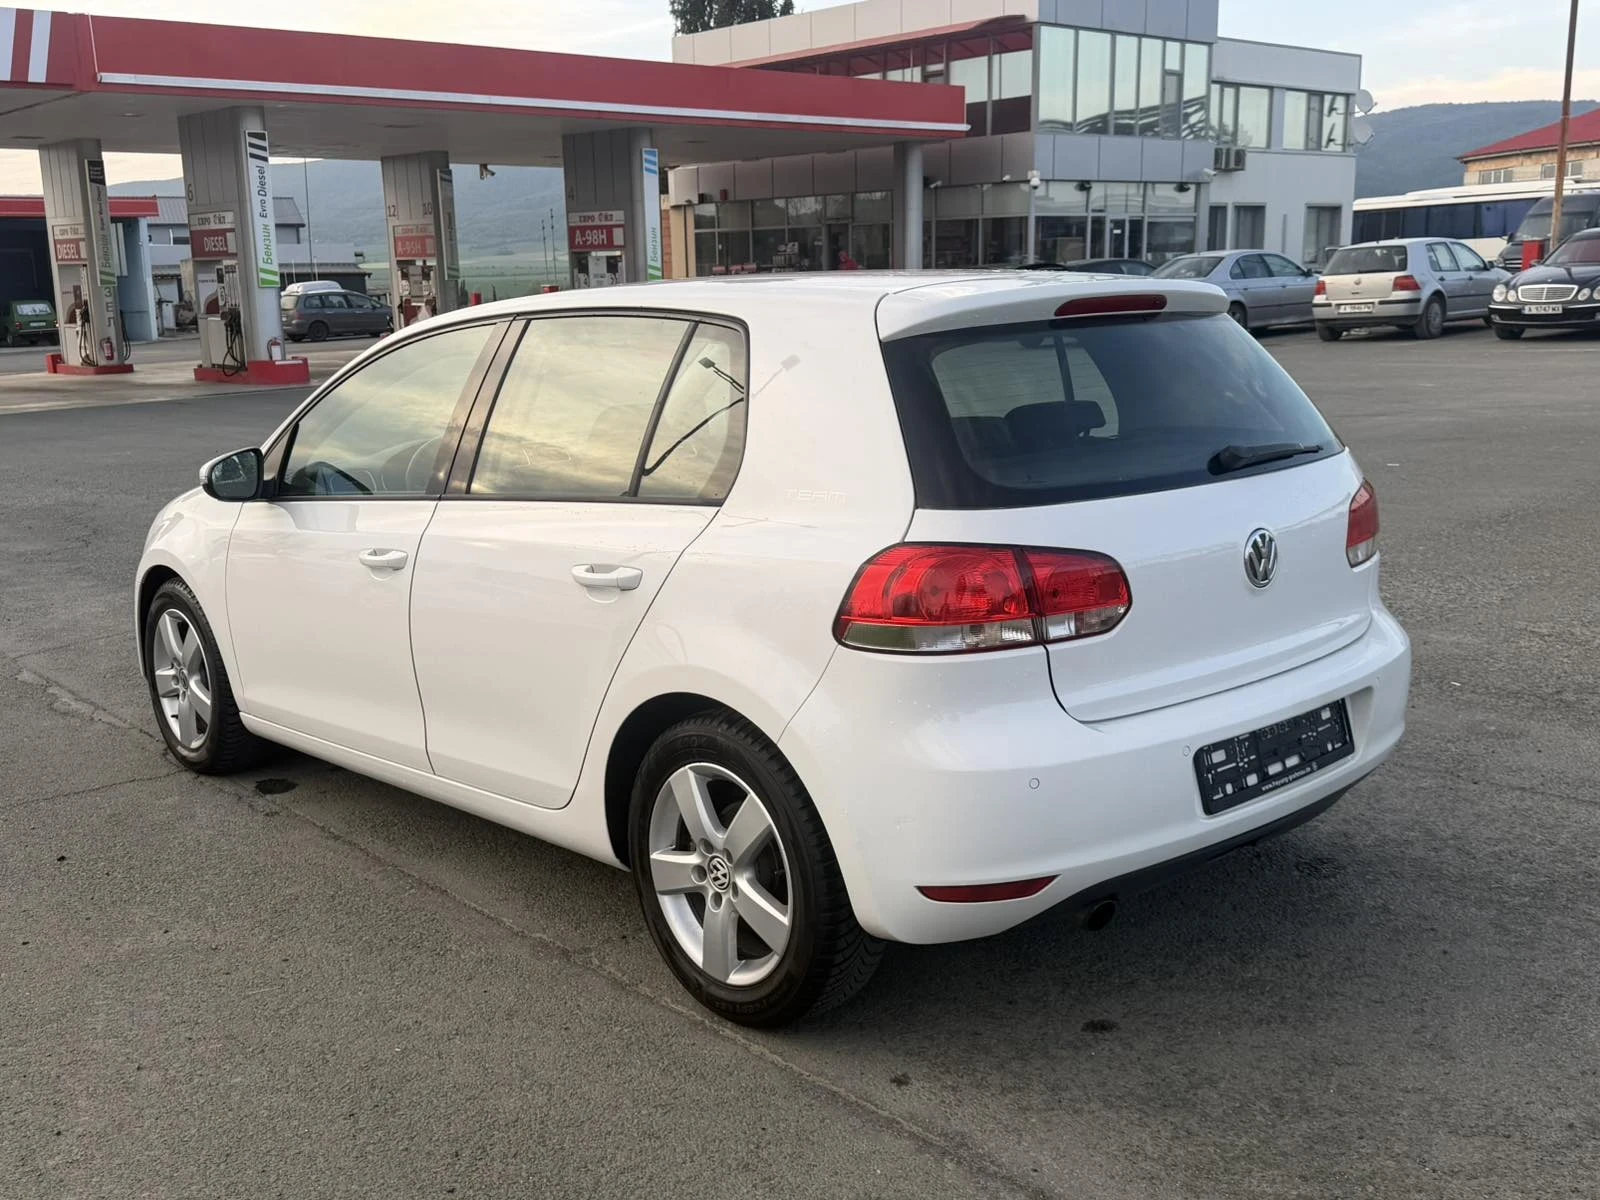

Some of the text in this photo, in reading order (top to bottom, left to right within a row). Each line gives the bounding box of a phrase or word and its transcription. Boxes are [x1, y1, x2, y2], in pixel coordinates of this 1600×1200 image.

[187, 183, 195, 203] 6
[256, 165, 273, 265] Бензин Evro Diesel
[387, 204, 397, 218] 12
[56, 243, 79, 259] DIESEL
[203, 236, 228, 252] DIESEL
[650, 226, 659, 263] Бензин
